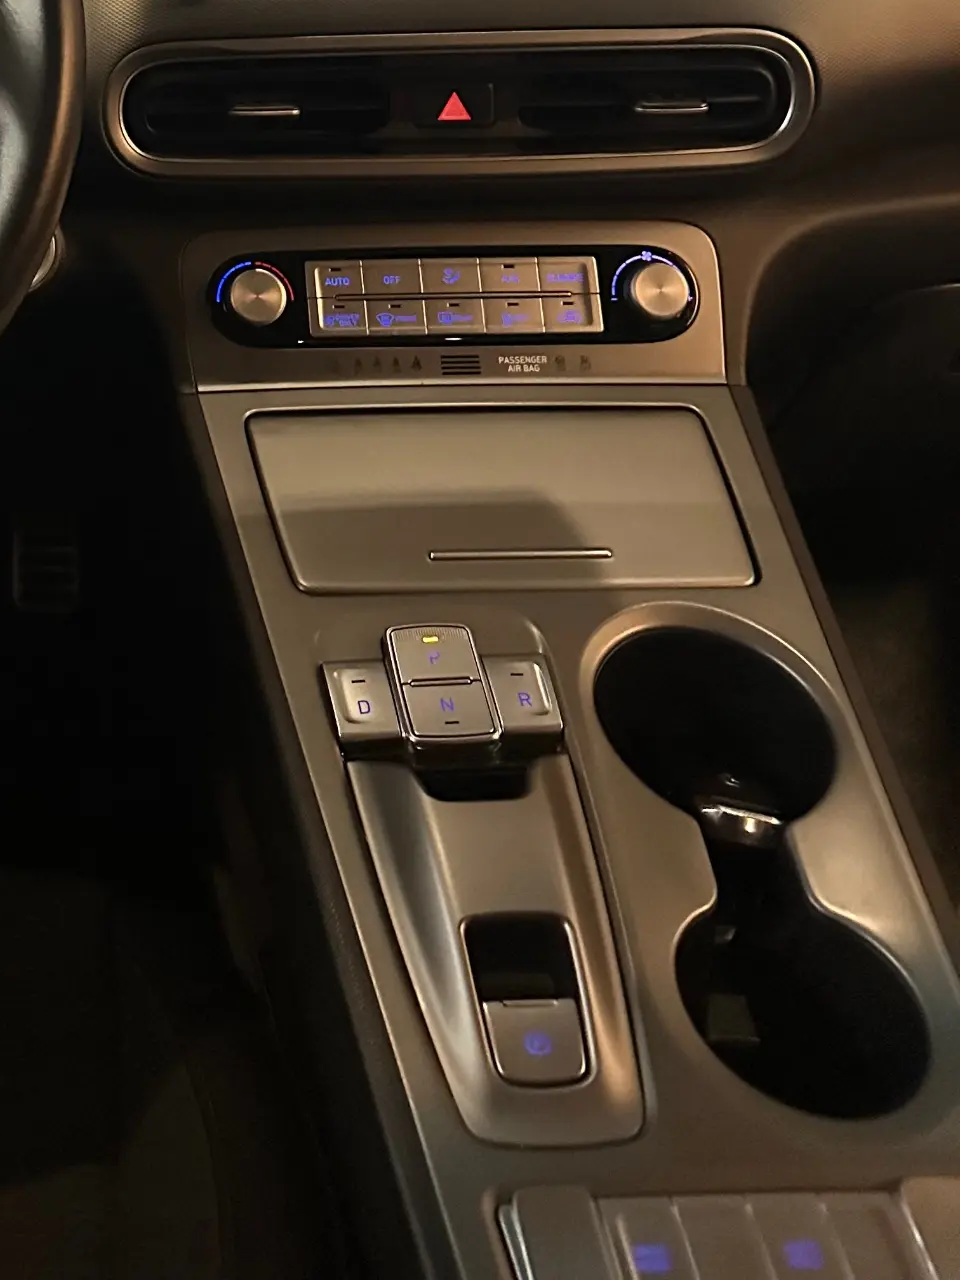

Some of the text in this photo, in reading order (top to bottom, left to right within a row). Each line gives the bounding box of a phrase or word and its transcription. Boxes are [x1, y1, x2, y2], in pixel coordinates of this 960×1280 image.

[324, 277, 350, 286] AUTO
[383, 275, 401, 285] OFF
[498, 355, 547, 364] PASSENGER
[507, 364, 540, 372] AIR BAG
[441, 697, 455, 712] N
[518, 692, 533, 707] R
[357, 699, 371, 715] D
